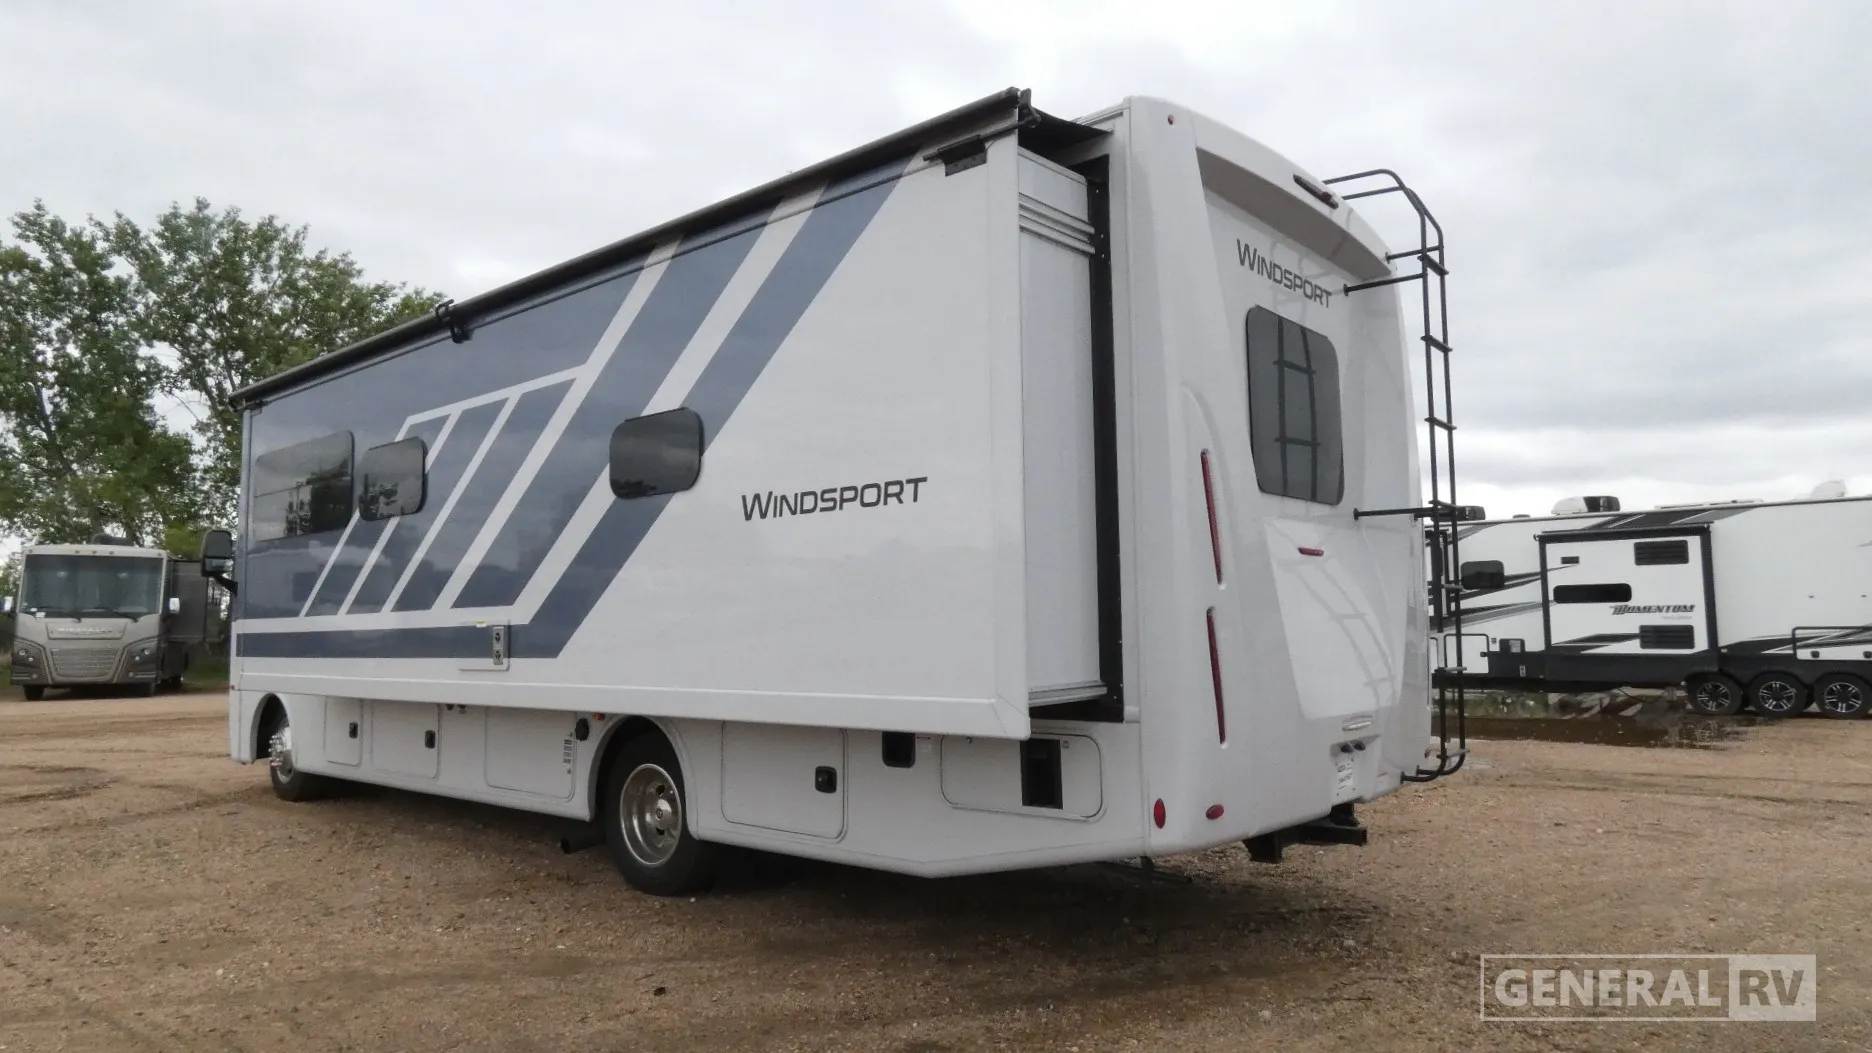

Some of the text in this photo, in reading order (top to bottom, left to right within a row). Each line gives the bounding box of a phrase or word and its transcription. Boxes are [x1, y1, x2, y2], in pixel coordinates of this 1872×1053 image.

[1236, 238, 1333, 309] WINDSPORT
[741, 476, 929, 522] WINDSPORT
[1609, 604, 1696, 616] MOMENTUM
